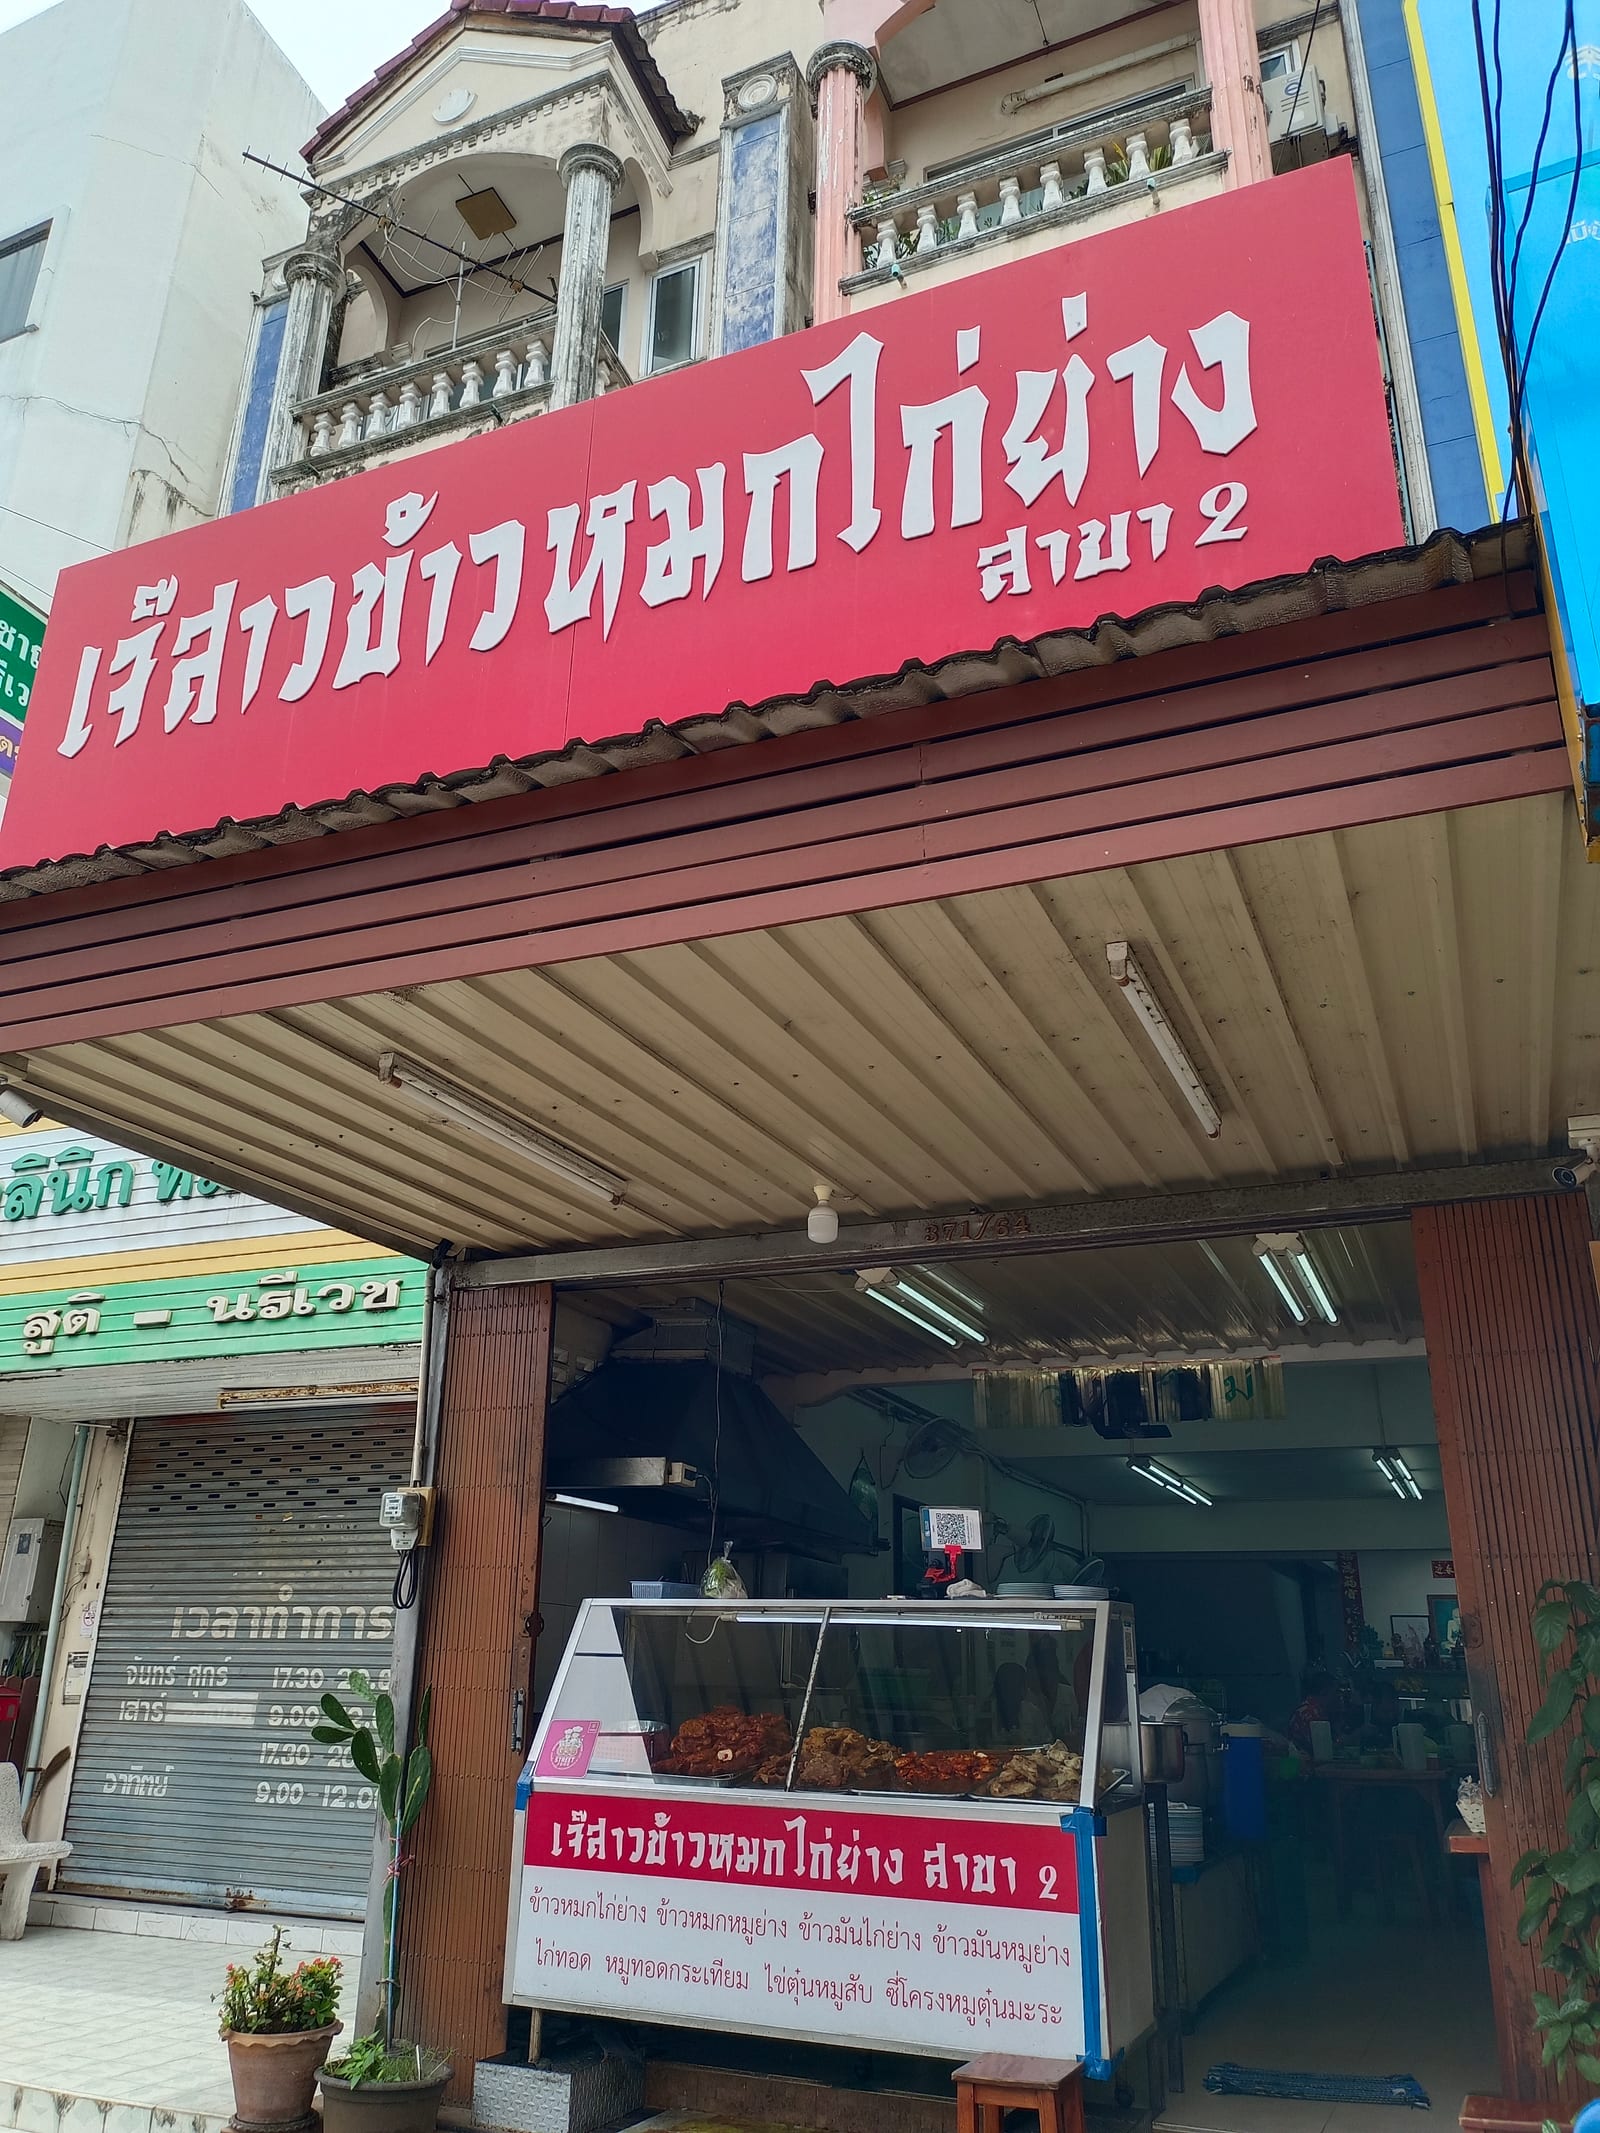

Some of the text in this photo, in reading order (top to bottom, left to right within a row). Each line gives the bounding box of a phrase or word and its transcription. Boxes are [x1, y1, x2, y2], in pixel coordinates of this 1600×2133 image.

[977, 481, 1249, 602] สาขา 2
[0, 1145, 136, 1222] ลินิก
[22, 1291, 106, 1356] สูติ
[206, 1270, 402, 1324] นรีเวช
[171, 1584, 394, 1640] เวลาทำการ
[550, 1809, 1059, 1901] เจ๊สาวข้าวหมกไก่ย่าง สาขา 2
[529, 1886, 1071, 1974] ข้าวหมกไก่ย่าง ข้าวหมกหมูย่าง ข้าวมันไก่ย่าง ข้าวมันหมูย่าง
[535, 1937, 1063, 2027] ไก่ทอด หมูทอดกระเทียม ไข่ตุ๋นหมูสับ ซี่โครงหมูตุ๋นมะระ
